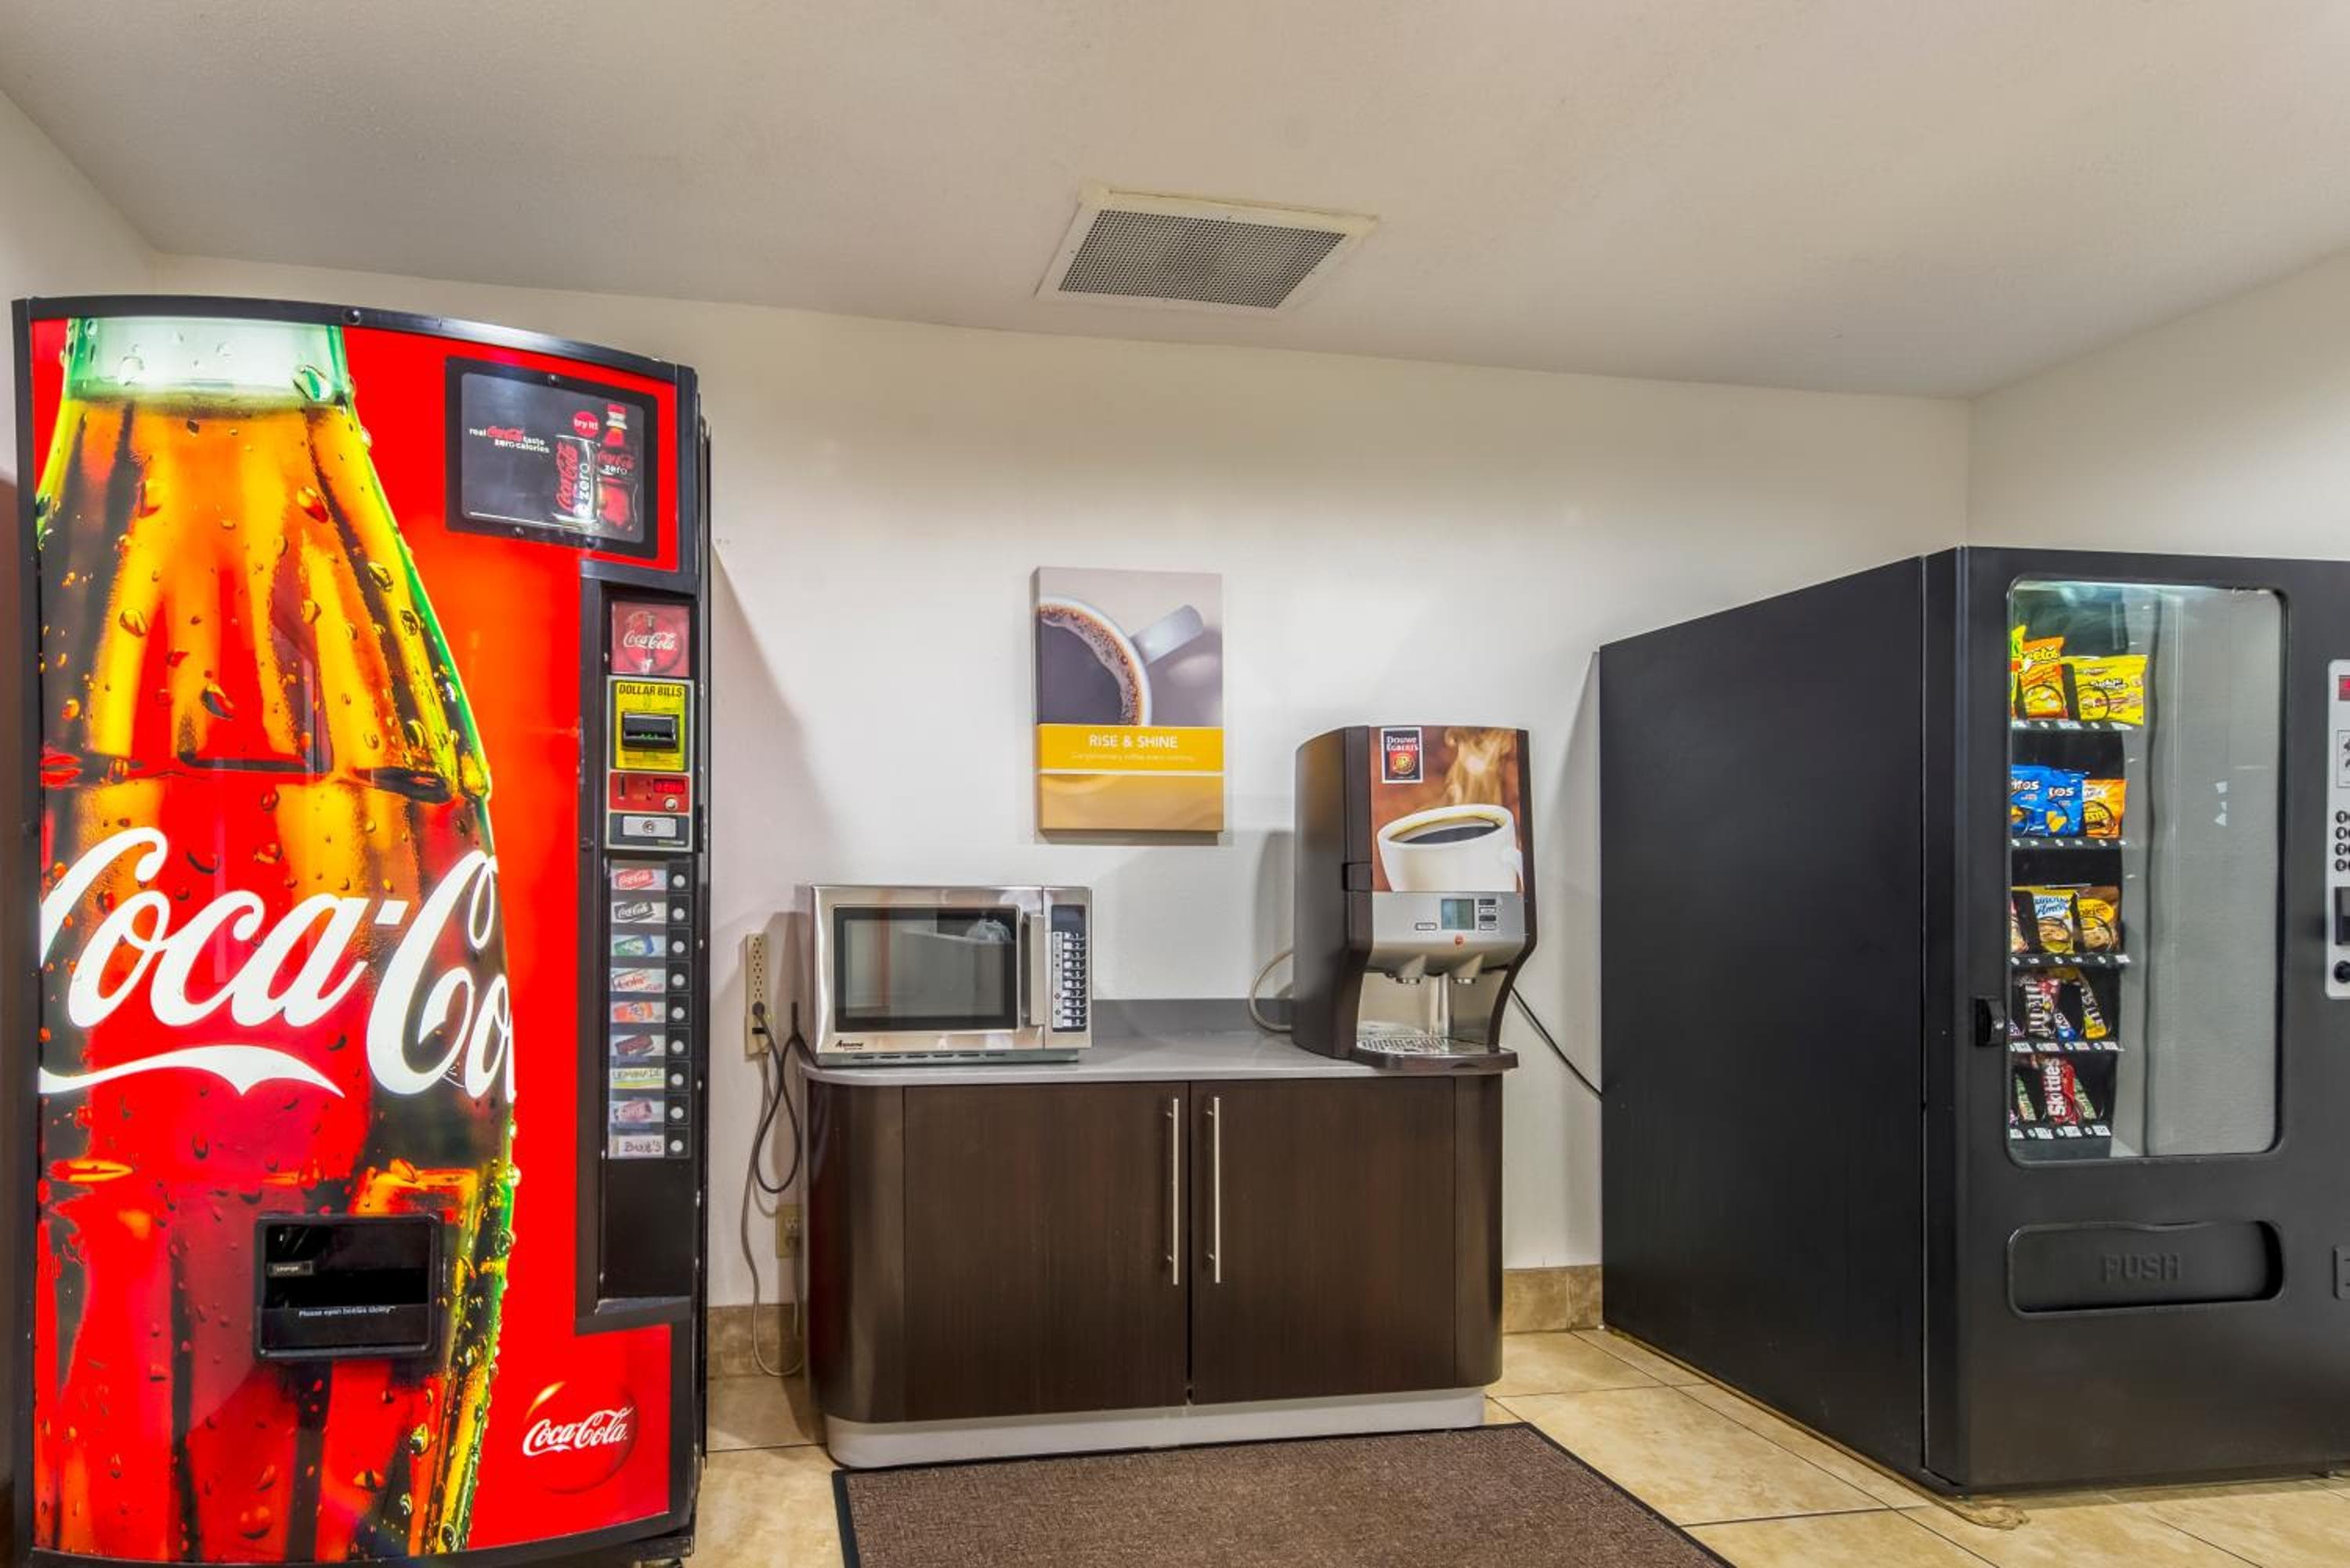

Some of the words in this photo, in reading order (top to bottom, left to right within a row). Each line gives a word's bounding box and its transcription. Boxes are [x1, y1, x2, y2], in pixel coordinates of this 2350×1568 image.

[469, 428, 486, 436] real
[573, 418, 588, 429] try
[604, 464, 627, 475] zero
[580, 463, 590, 500] zero
[624, 630, 677, 651] Coca-Cola
[619, 684, 656, 695] DOLLAR
[657, 686, 682, 697] BILLS
[1090, 735, 1118, 747] RISE
[1123, 736, 1132, 747] &
[1137, 735, 1178, 748] SHINE
[2043, 1058, 2066, 1116] Skittles
[2103, 1252, 2181, 1282] PUSH
[522, 1407, 633, 1458] Coca-Cola
